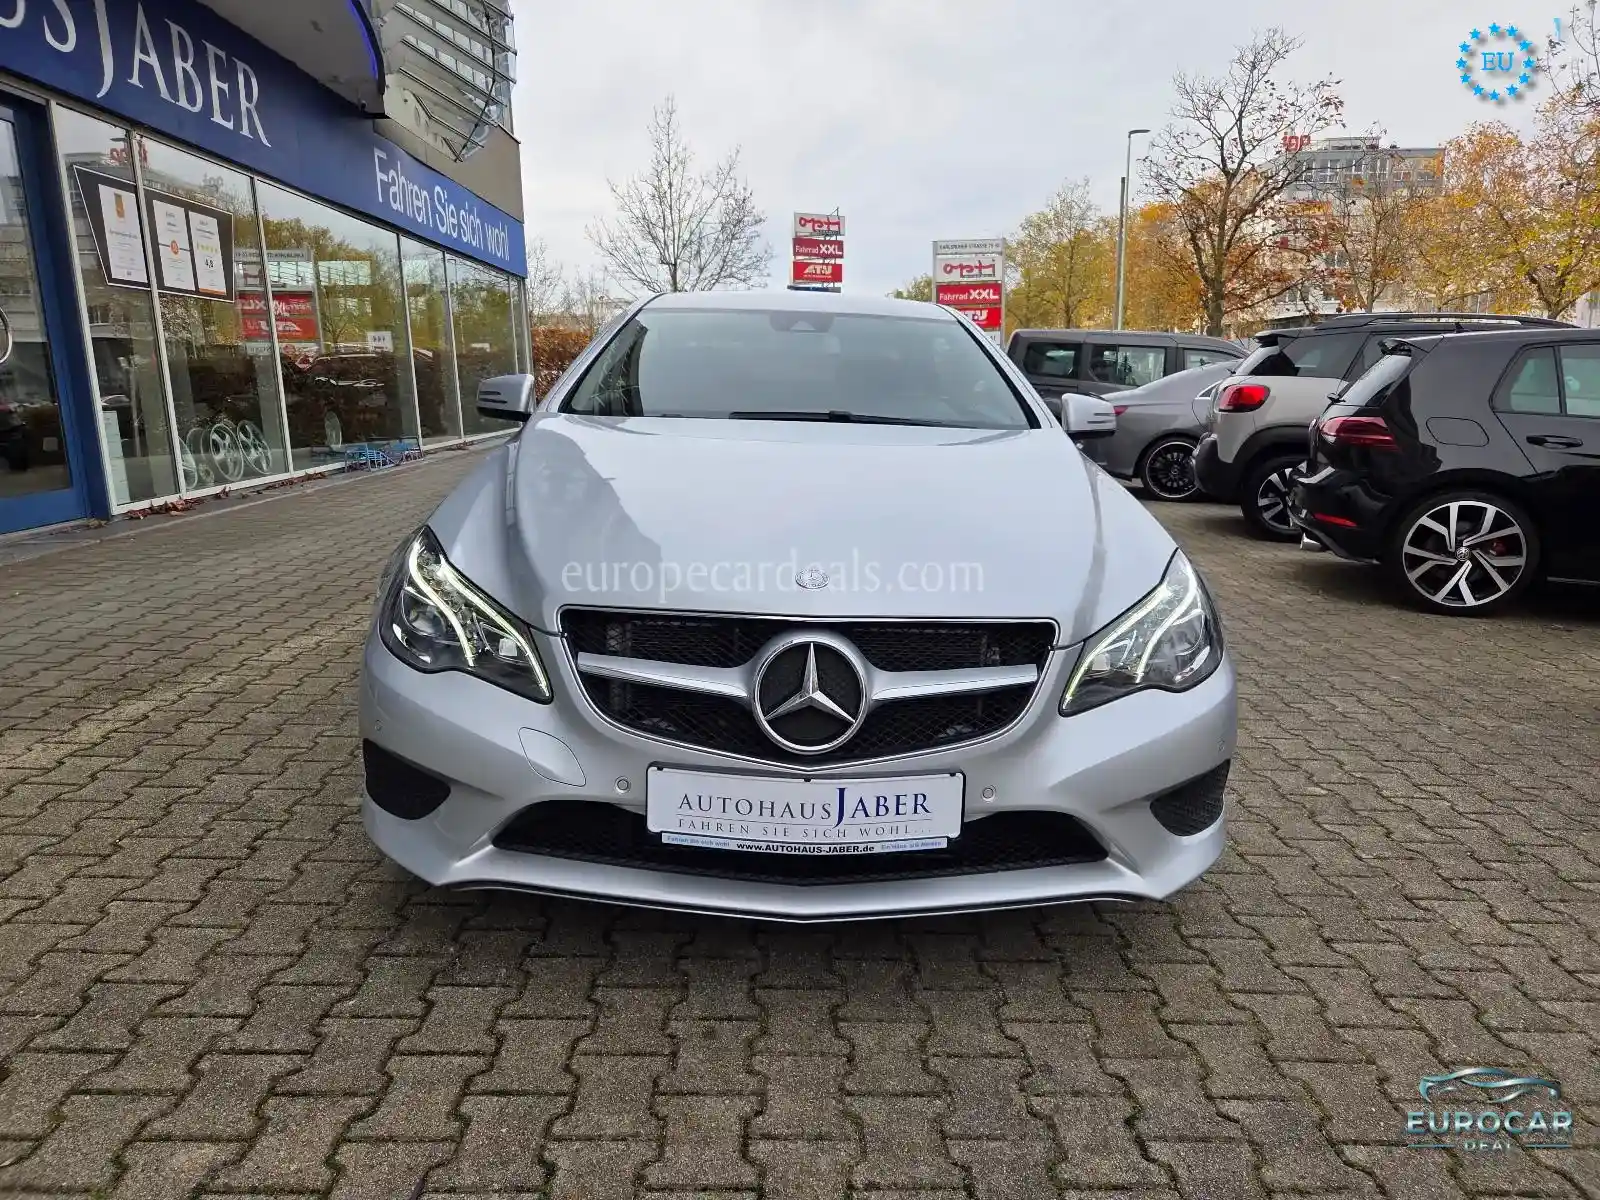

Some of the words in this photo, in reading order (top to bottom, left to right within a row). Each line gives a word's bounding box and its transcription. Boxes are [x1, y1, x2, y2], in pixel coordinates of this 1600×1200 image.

[374, 147, 433, 227] Fahren
[434, 185, 458, 238] Sie
[459, 201, 484, 251] sich
[795, 245, 819, 254] Fahrrad
[819, 244, 842, 255] XXL
[943, 259, 996, 278] opti
[939, 293, 968, 301] Fahrrad
[969, 289, 999, 299] XXL
[678, 818, 750, 834] FAHREN
[762, 826, 790, 837] SIE
[802, 828, 846, 838] SICH
[736, 843, 875, 854] www.AUTOHAUS-JABER.de
